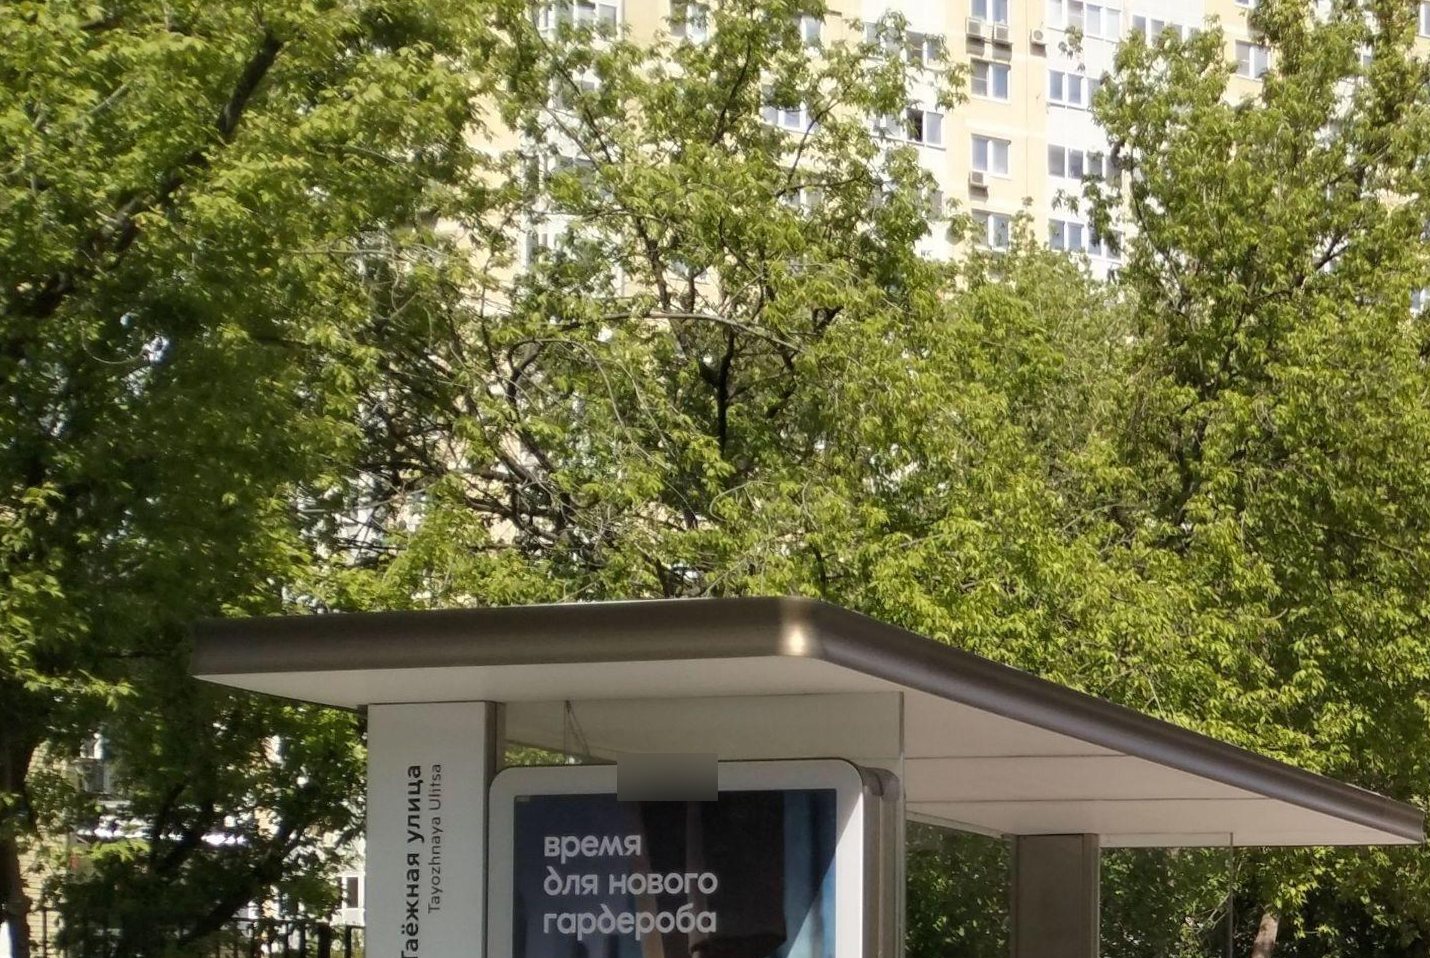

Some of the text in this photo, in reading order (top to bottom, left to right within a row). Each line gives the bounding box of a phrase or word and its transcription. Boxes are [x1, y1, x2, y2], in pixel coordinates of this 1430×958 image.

[407, 765, 425, 844] улица
[428, 764, 444, 914] Tayozhnaya Ulitsa
[543, 833, 641, 864] время
[543, 866, 718, 896] для нового
[543, 903, 717, 941] гардероба
